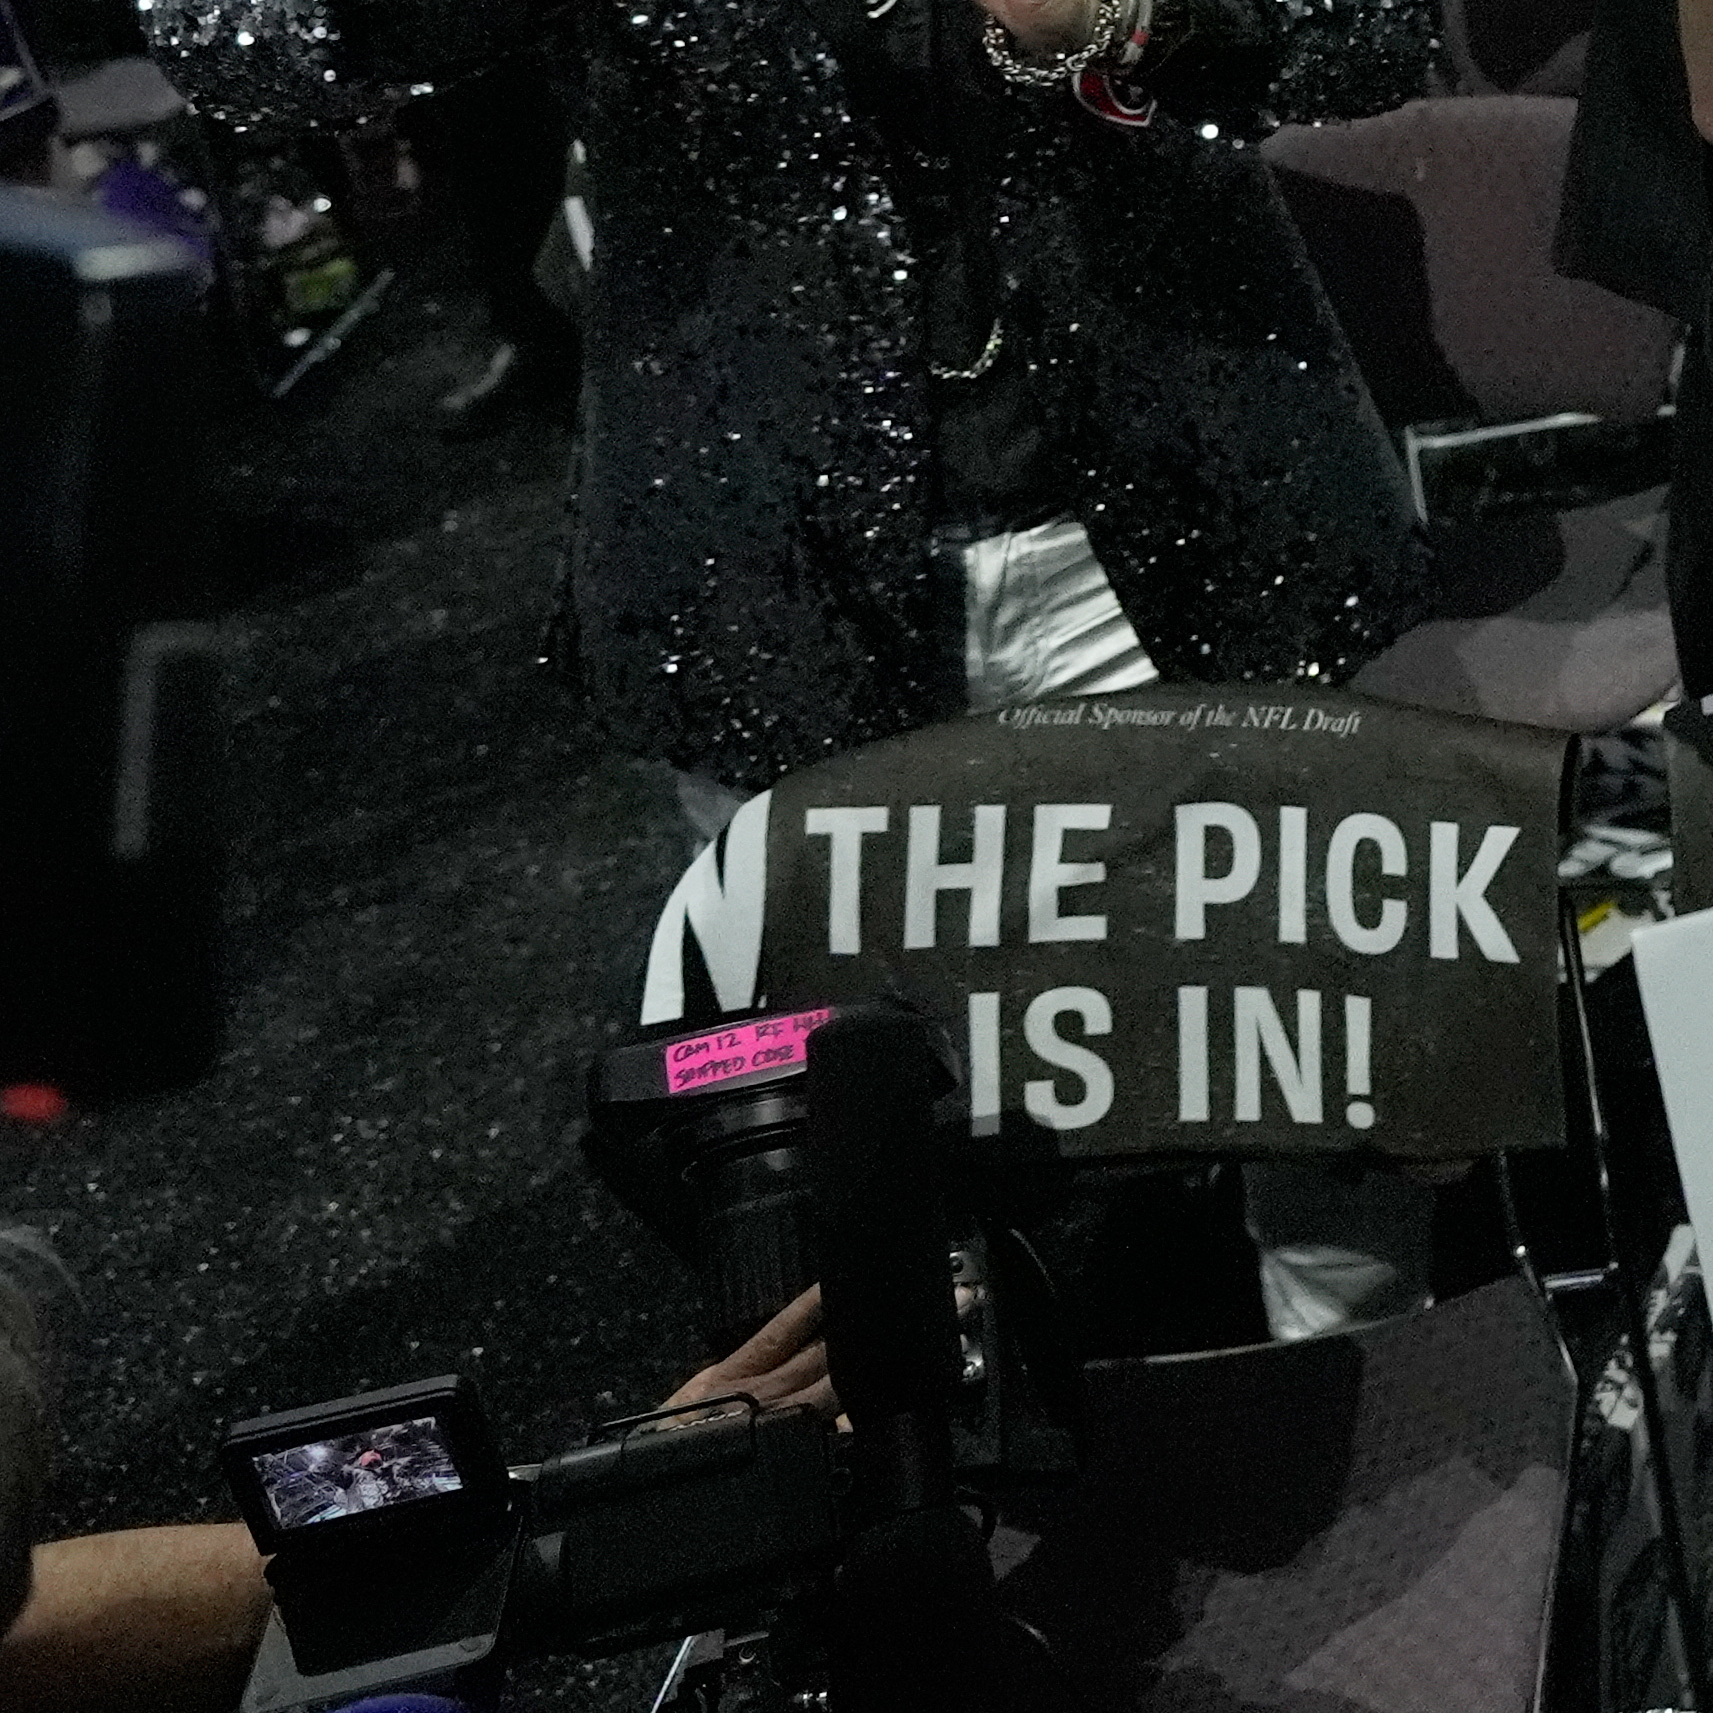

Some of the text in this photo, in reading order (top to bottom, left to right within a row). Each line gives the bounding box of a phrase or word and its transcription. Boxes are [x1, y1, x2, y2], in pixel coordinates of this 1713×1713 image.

[999, 701, 1363, 737] Official Sponsor of the NFL Draft
[804, 801, 1522, 964] THE PICK
[716, 1032, 742, 1051] 12
[967, 984, 1376, 1137] IS IN!
